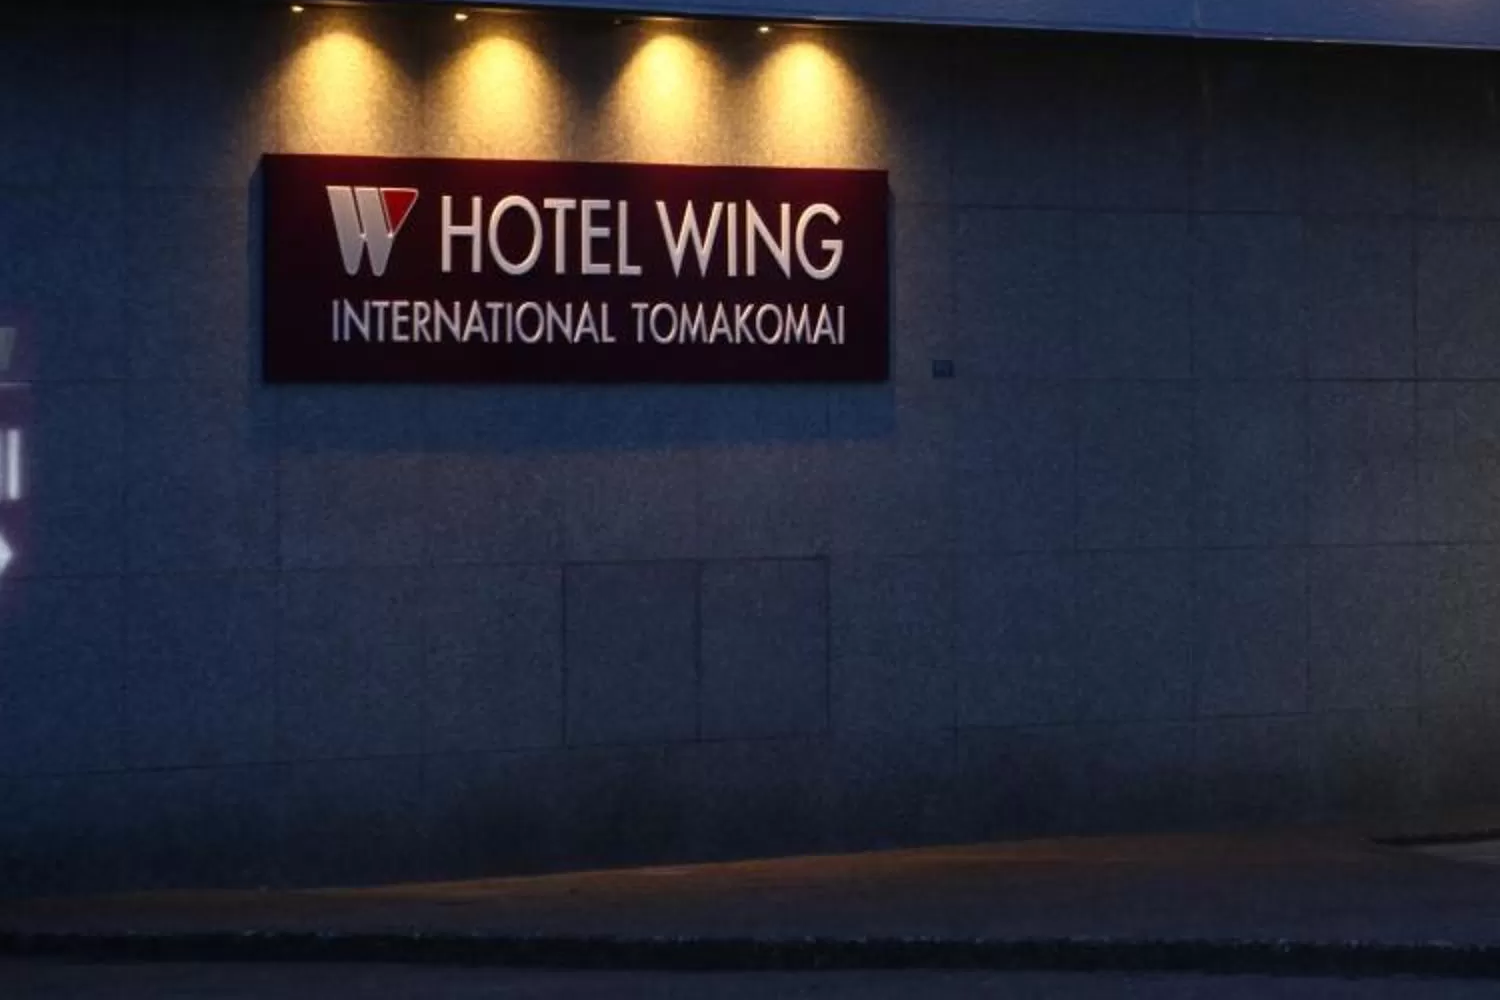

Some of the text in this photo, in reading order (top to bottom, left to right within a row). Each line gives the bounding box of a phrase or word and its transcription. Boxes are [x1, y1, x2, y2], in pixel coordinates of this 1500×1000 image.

[442, 195, 641, 275] HOTEL
[656, 200, 843, 279] WING
[332, 299, 845, 345] INTERNATIONAL TOMAKOMAI
